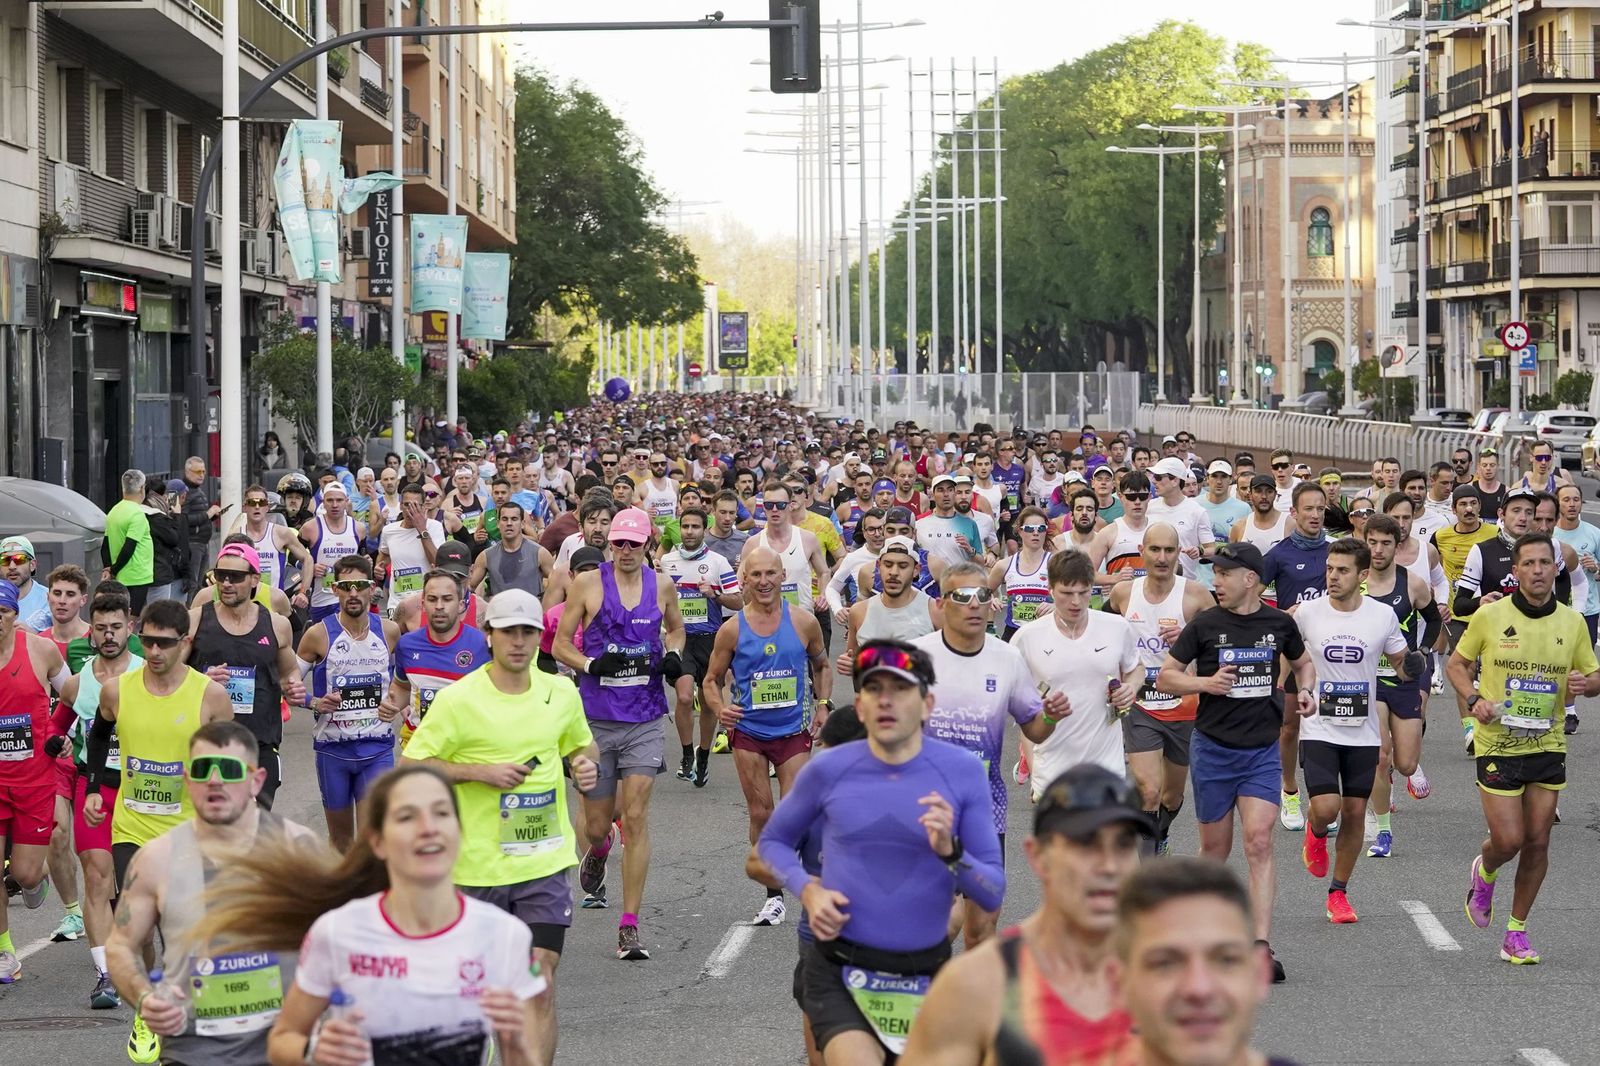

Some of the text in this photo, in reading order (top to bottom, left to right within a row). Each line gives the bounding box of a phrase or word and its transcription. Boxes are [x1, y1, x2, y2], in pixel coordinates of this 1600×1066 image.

[620, 645, 646, 655] ZURICH
[1238, 651, 1267, 660] ZURICH
[1494, 659, 1529, 672] AMIGOS
[766, 669, 793, 677] ZURICH
[350, 676, 376, 684] ZURICH
[1523, 682, 1551, 691] ZURICH
[761, 692, 789, 702] ETHAN
[1335, 706, 1354, 716] EDU
[1517, 705, 1542, 718] SEPE
[930, 719, 951, 730] Club
[937, 729, 981, 742] Caravaca
[144, 764, 176, 774] ZURICH
[134, 788, 172, 802] VICTOR
[524, 794, 552, 806] ZURICH
[219, 953, 269, 971] ZURICH
[224, 981, 250, 994] 1695
[870, 978, 919, 991] ZURICH
[196, 999, 284, 1018] DARREN MOONEY
[868, 1000, 895, 1012] 2813
